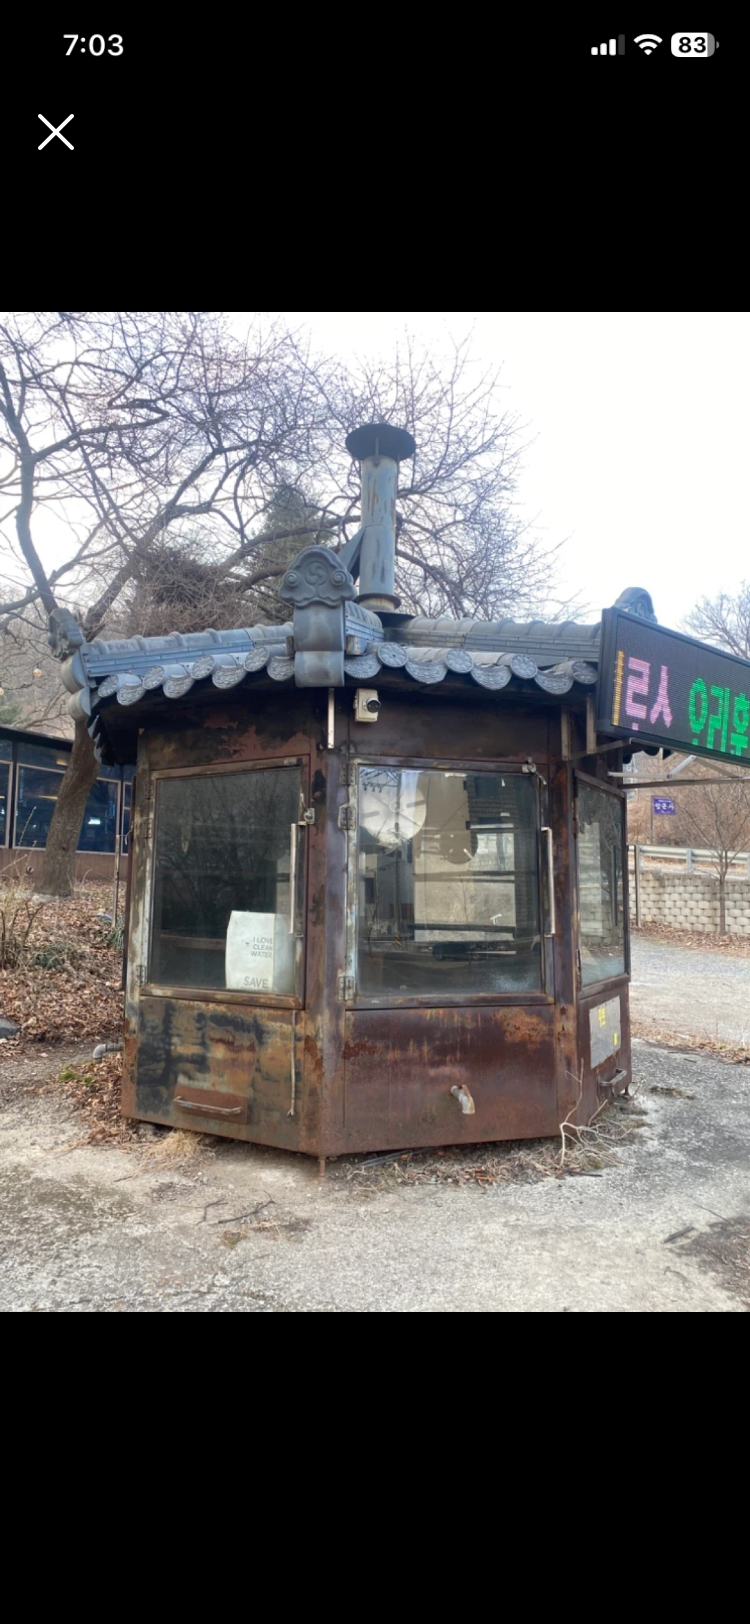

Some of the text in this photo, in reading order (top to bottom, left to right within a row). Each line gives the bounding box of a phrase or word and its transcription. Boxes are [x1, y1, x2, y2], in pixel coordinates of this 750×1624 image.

[257, 937, 273, 945] LOVE
[252, 943, 273, 951] CLEAN
[250, 950, 273, 958] WATER
[243, 976, 269, 989] SAVE
